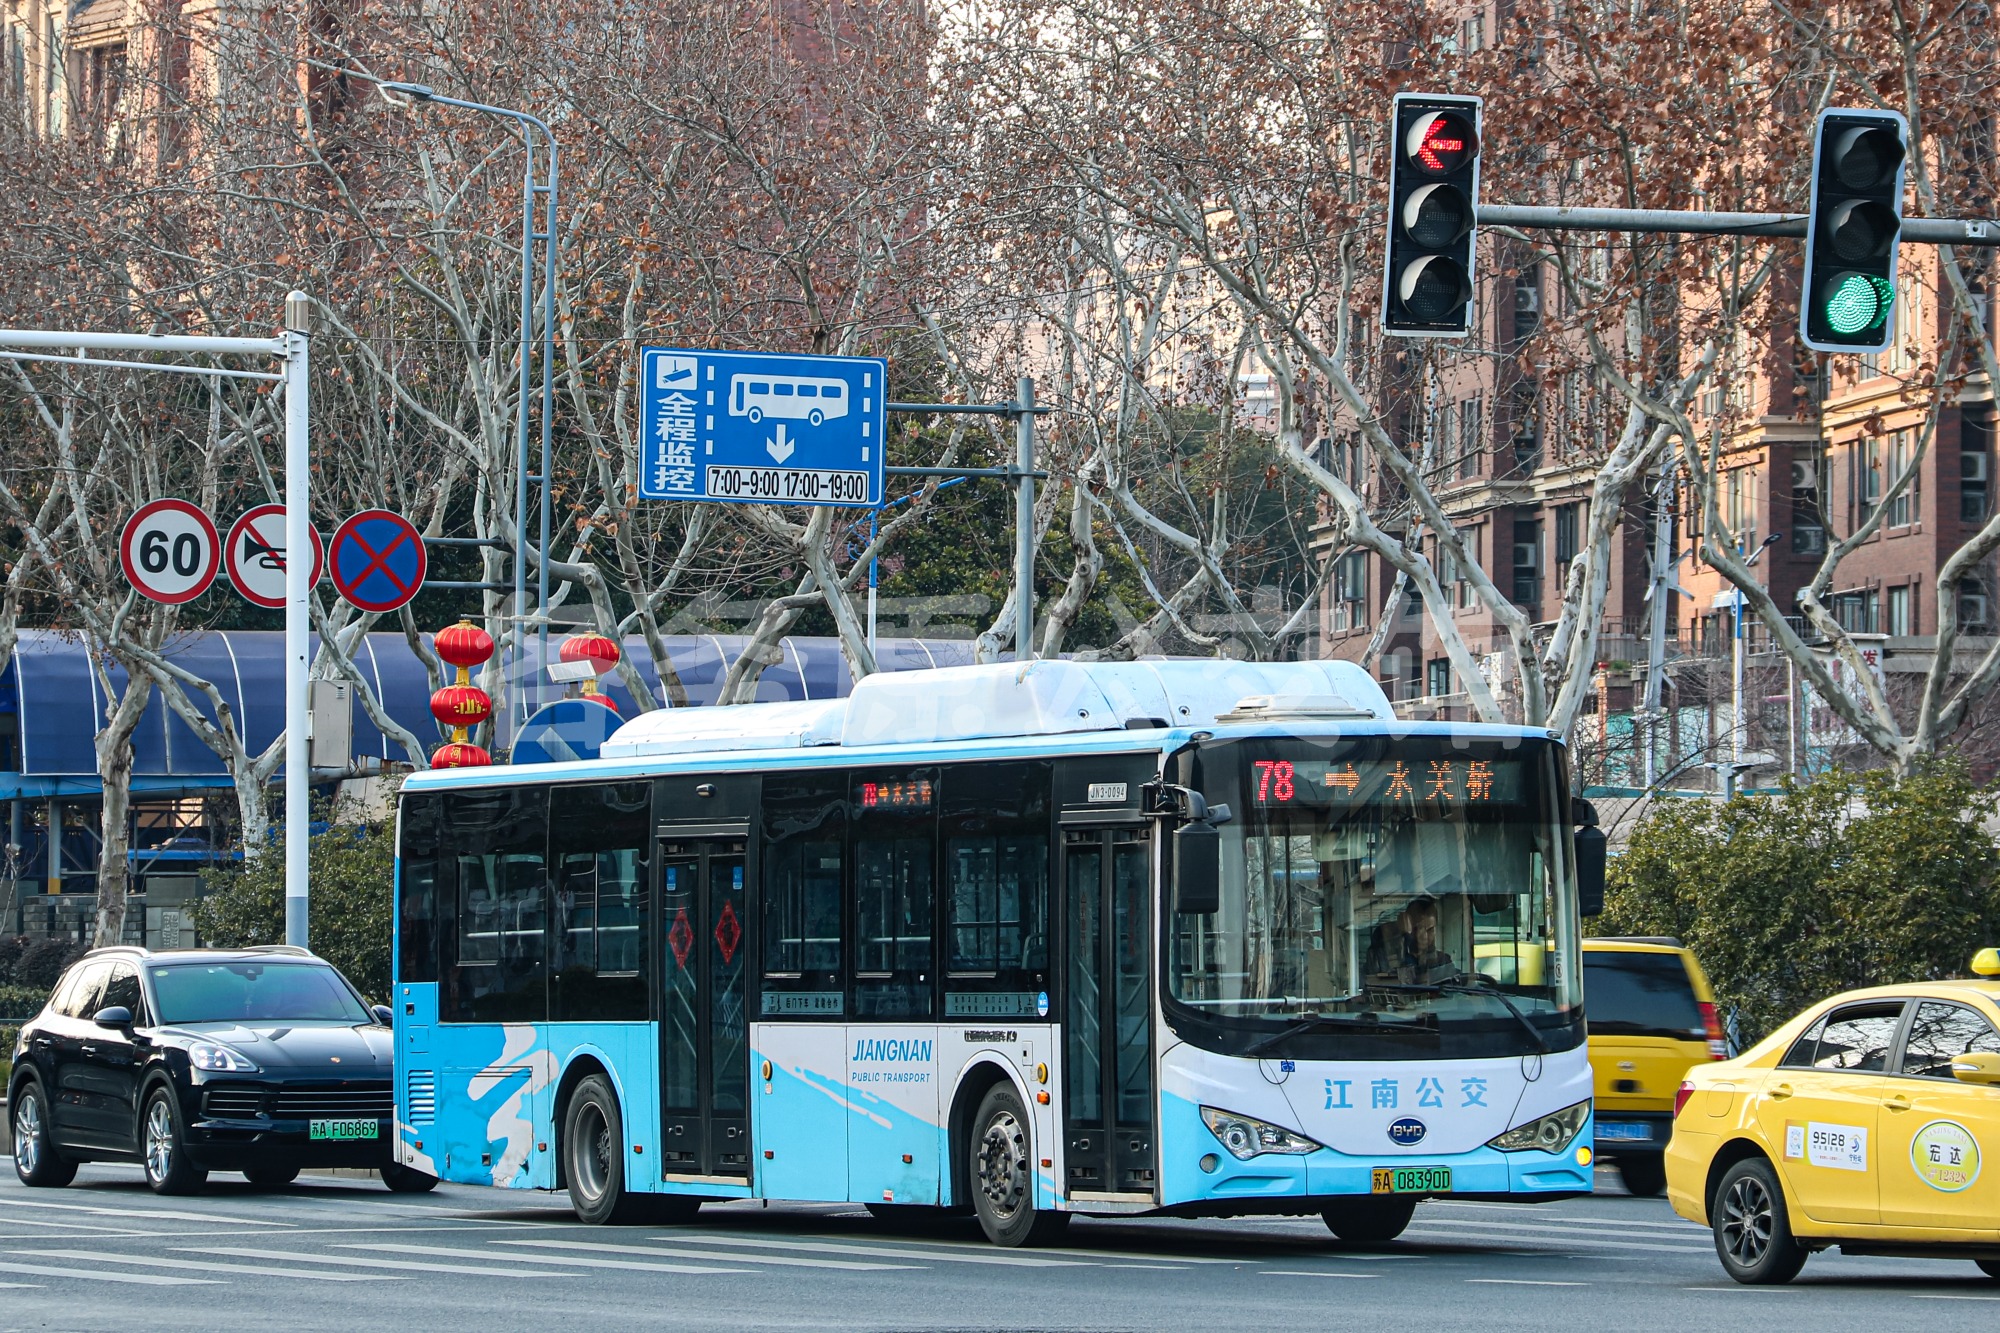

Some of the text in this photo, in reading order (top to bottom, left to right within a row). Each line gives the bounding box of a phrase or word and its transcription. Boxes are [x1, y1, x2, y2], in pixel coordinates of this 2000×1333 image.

[654, 391, 698, 493] 全程监控
[711, 469, 864, 501] 7:00-9:00 17:00-19:00
[139, 529, 201, 577] 60
[1253, 761, 1295, 801] 78
[1385, 760, 1494, 800] 水关桥
[1090, 786, 1125, 799] JN3-0094
[852, 1038, 932, 1063] JIANGNAN
[852, 1071, 931, 1084] PUBLIC TRANSPORT
[1324, 1077, 1488, 1111] 江南公交
[332, 1121, 376, 1137] F06869
[1392, 1125, 1423, 1137] BYD
[1812, 1131, 1845, 1147] 95128
[1929, 1144, 1961, 1165] 宏达
[1398, 1170, 1451, 1191] 08390D
[1938, 1169, 1967, 1184] 12328
